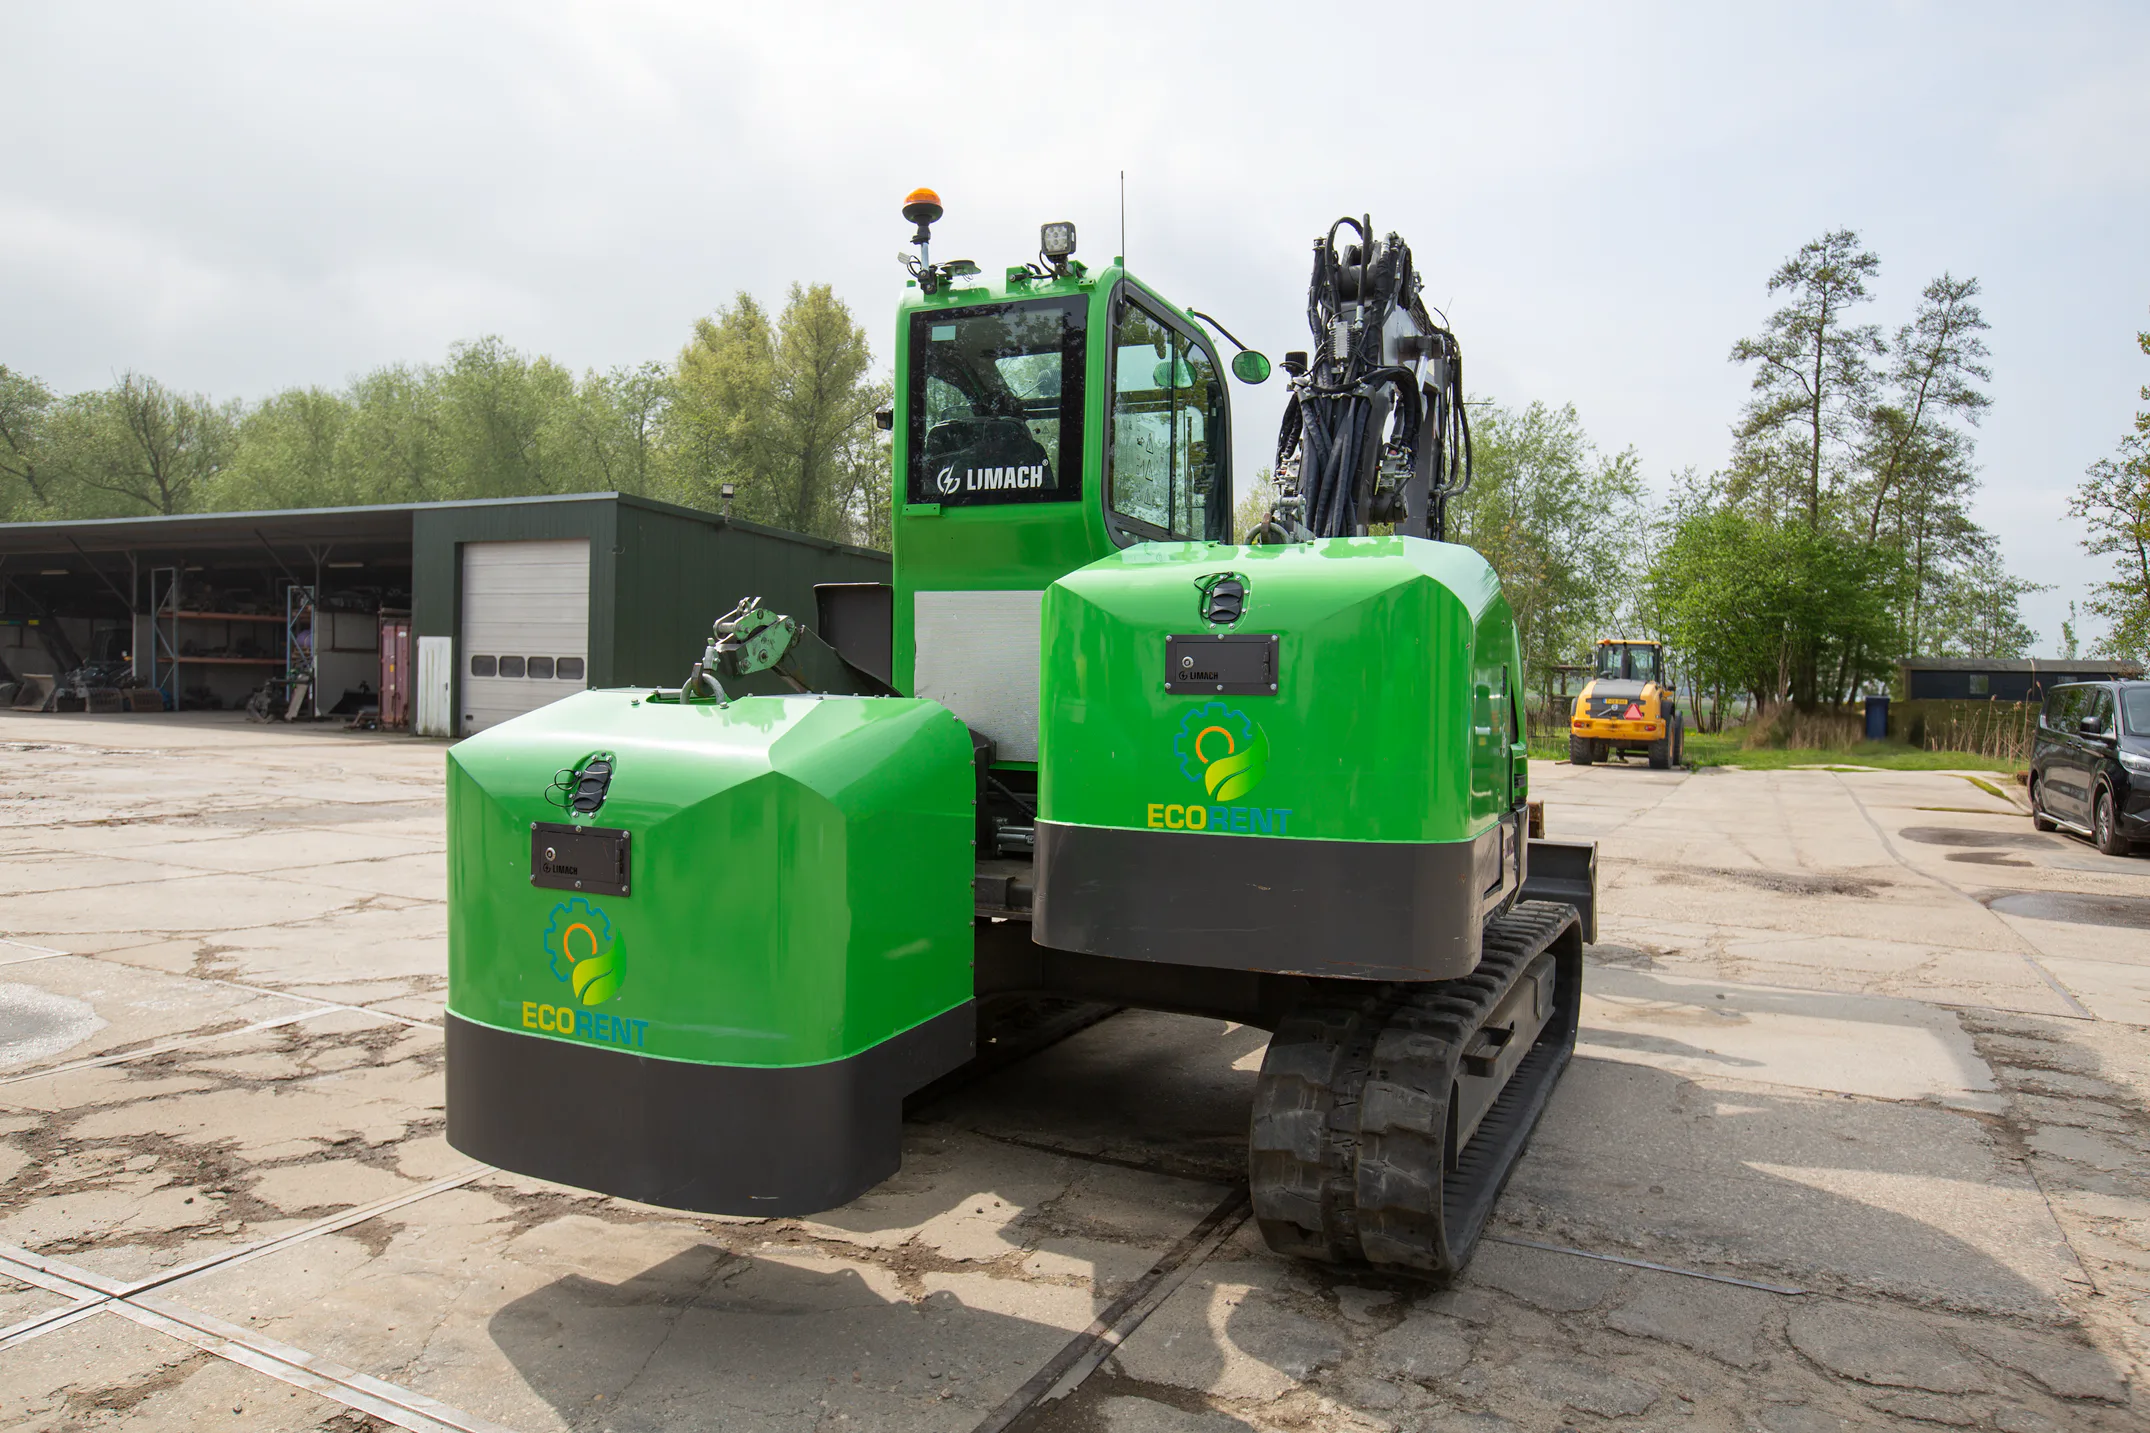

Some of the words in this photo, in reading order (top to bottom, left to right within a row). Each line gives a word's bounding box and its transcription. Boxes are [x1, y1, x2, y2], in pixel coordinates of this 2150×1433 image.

[967, 465, 1043, 491] LIMACH
[1190, 671, 1219, 680] LIMACH
[1147, 803, 1293, 834] ECORENT
[552, 864, 578, 875] LIMACH
[522, 1000, 649, 1047] ECORENT
